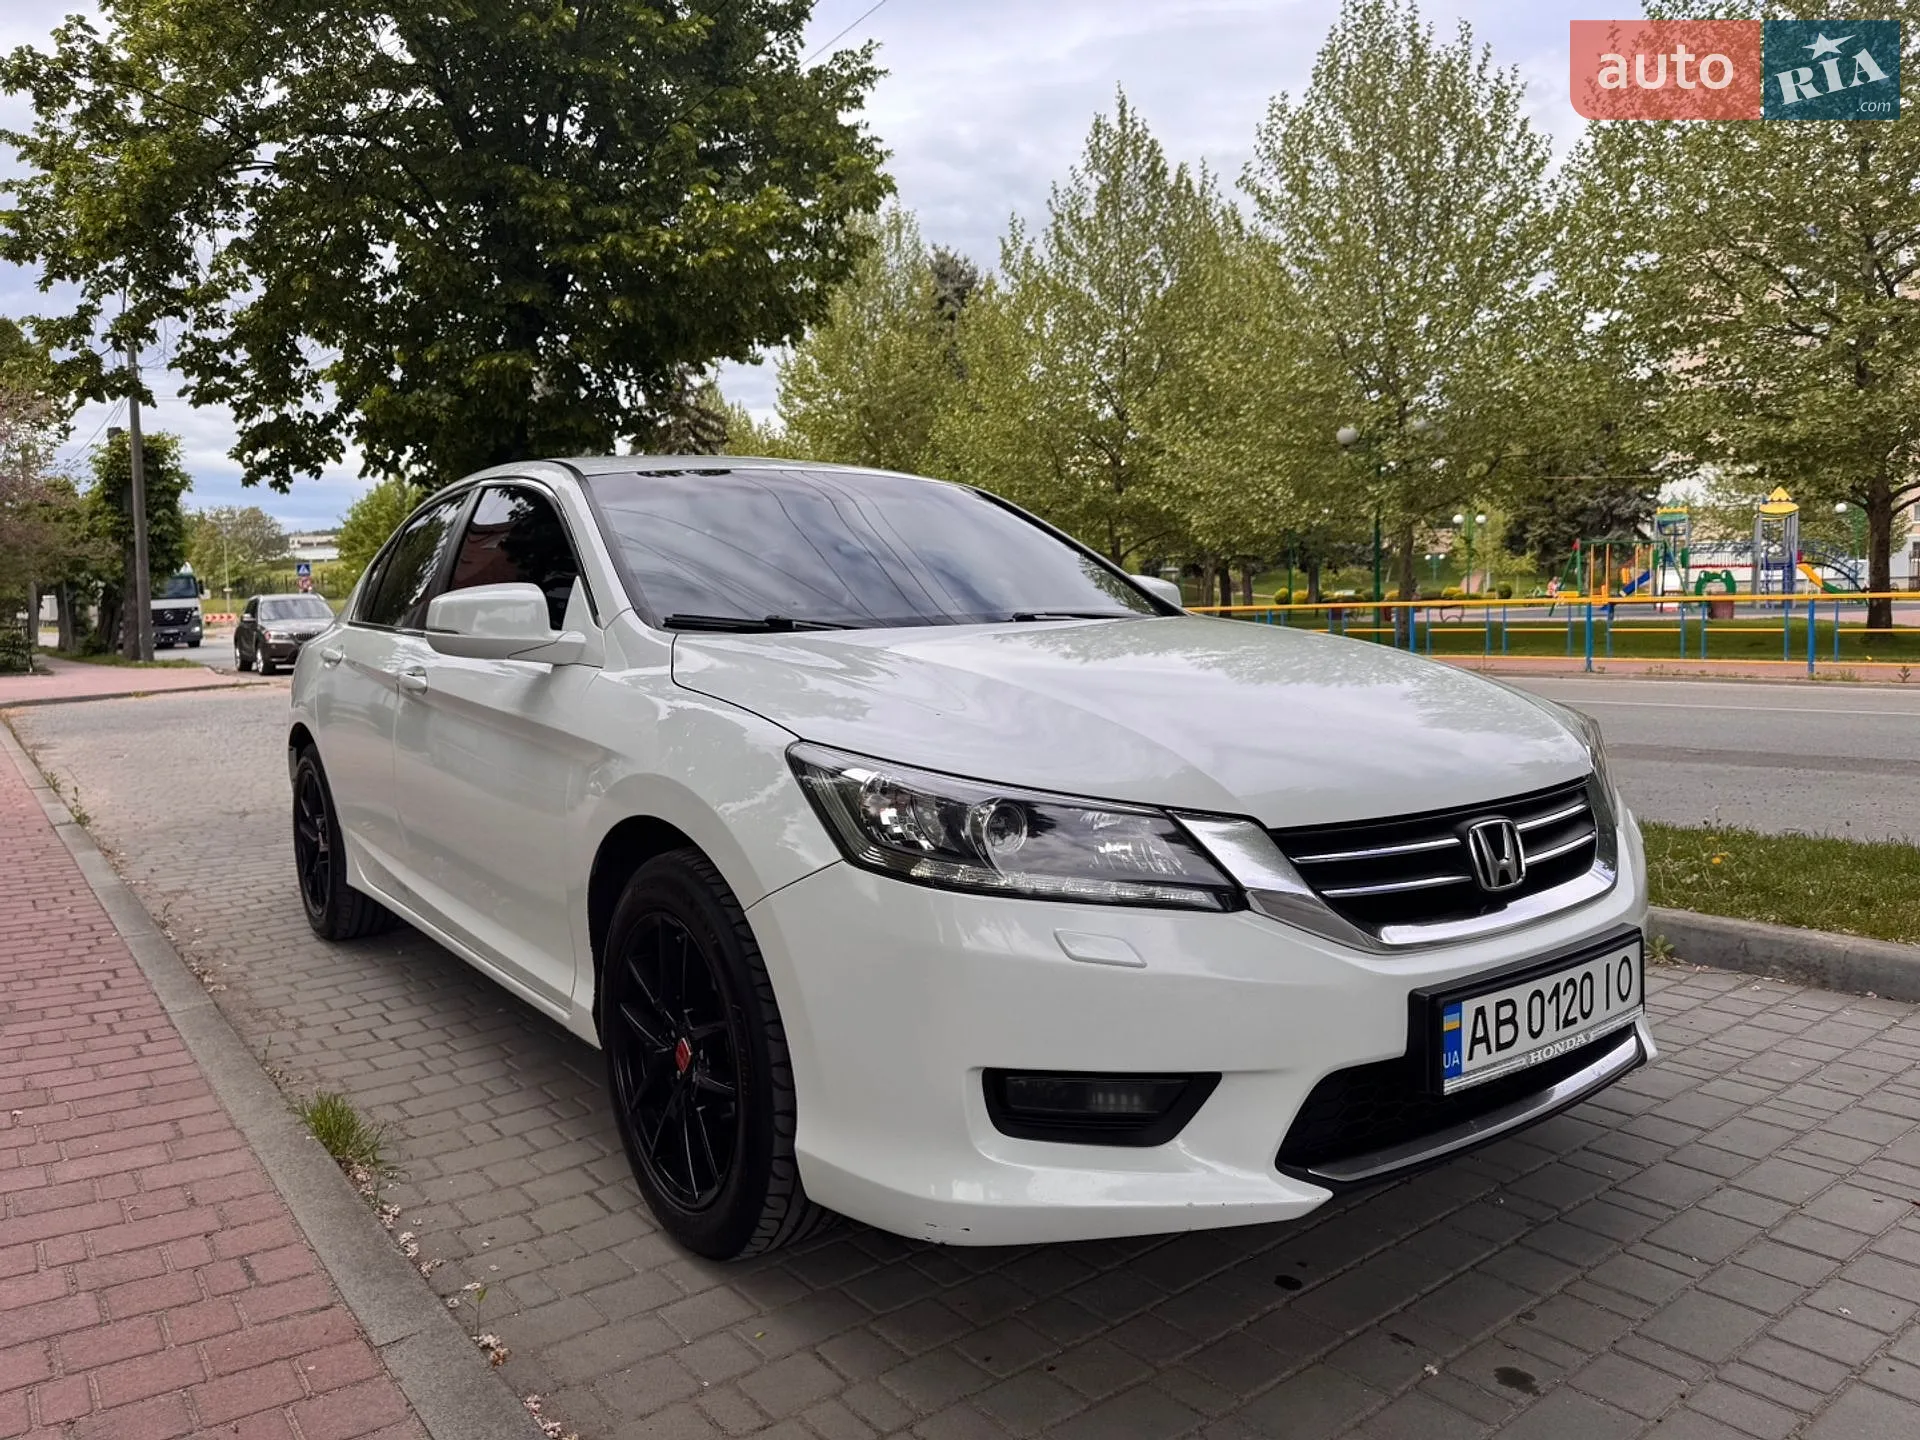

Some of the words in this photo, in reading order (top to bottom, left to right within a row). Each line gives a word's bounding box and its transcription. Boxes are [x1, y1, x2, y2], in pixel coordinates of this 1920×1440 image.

[1467, 998, 1519, 1061] AB
[1527, 971, 1594, 1039] 0120
[1605, 955, 1632, 1011] IO
[1443, 1050, 1460, 1069] UA
[1529, 1032, 1587, 1065] HONDA
